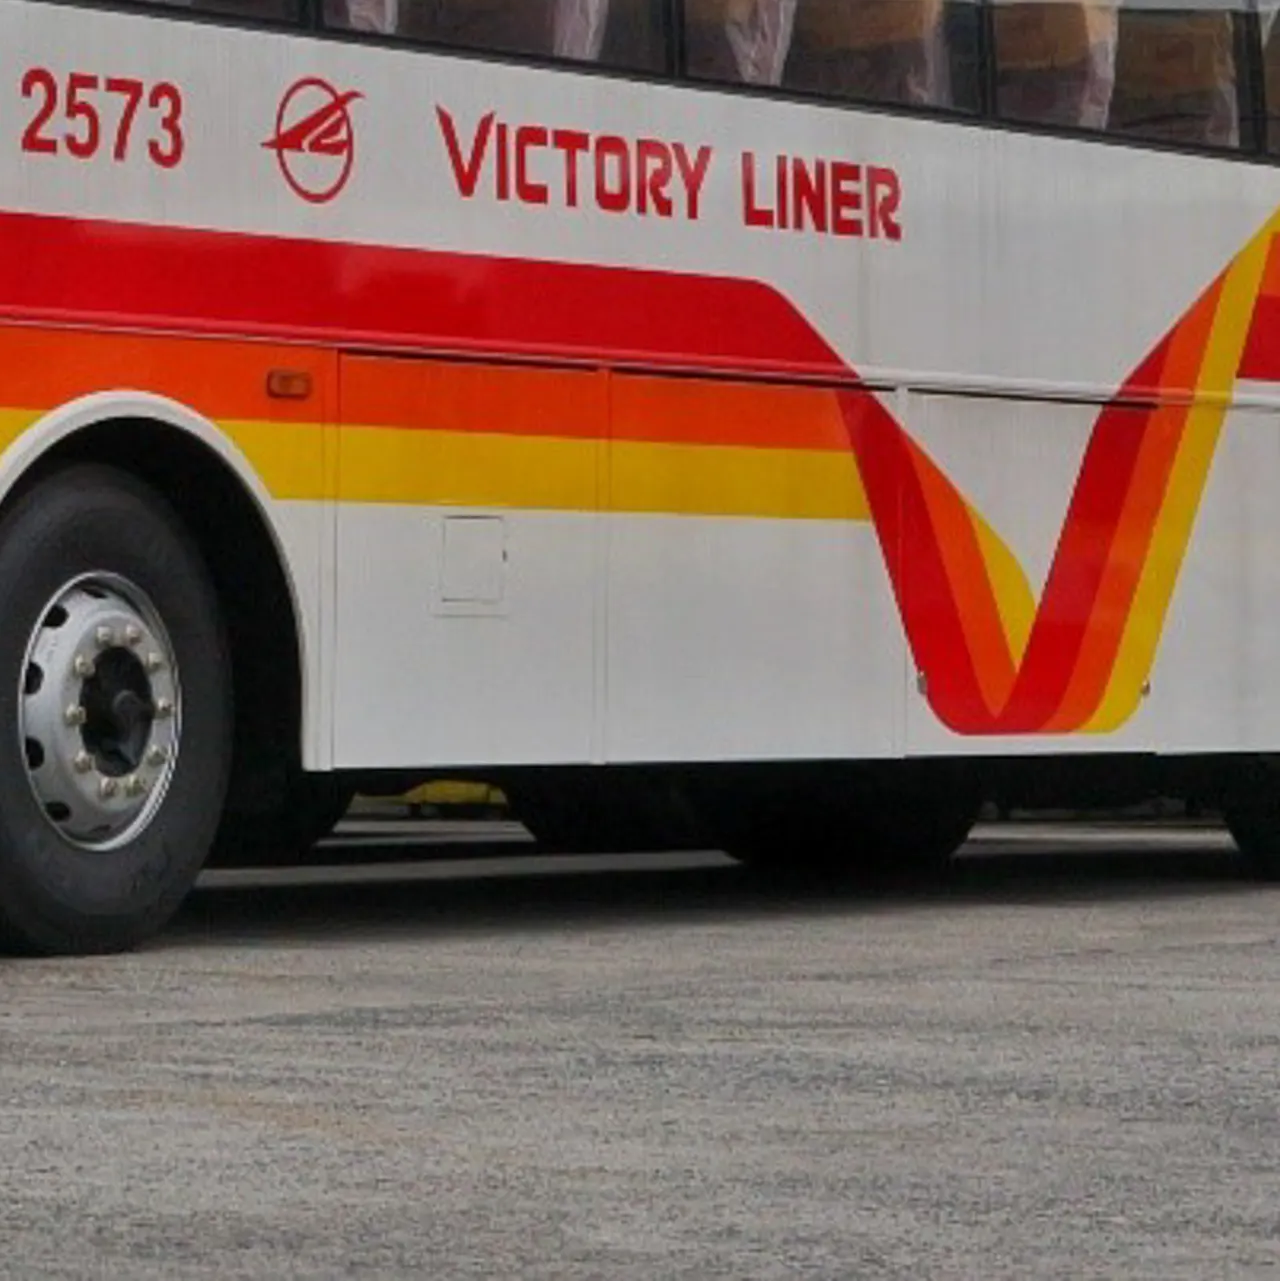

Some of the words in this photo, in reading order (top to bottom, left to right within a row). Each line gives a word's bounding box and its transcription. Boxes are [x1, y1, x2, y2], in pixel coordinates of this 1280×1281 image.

[21, 68, 184, 169] 2573
[435, 104, 712, 220] VICTORY
[741, 151, 901, 241] LINER
